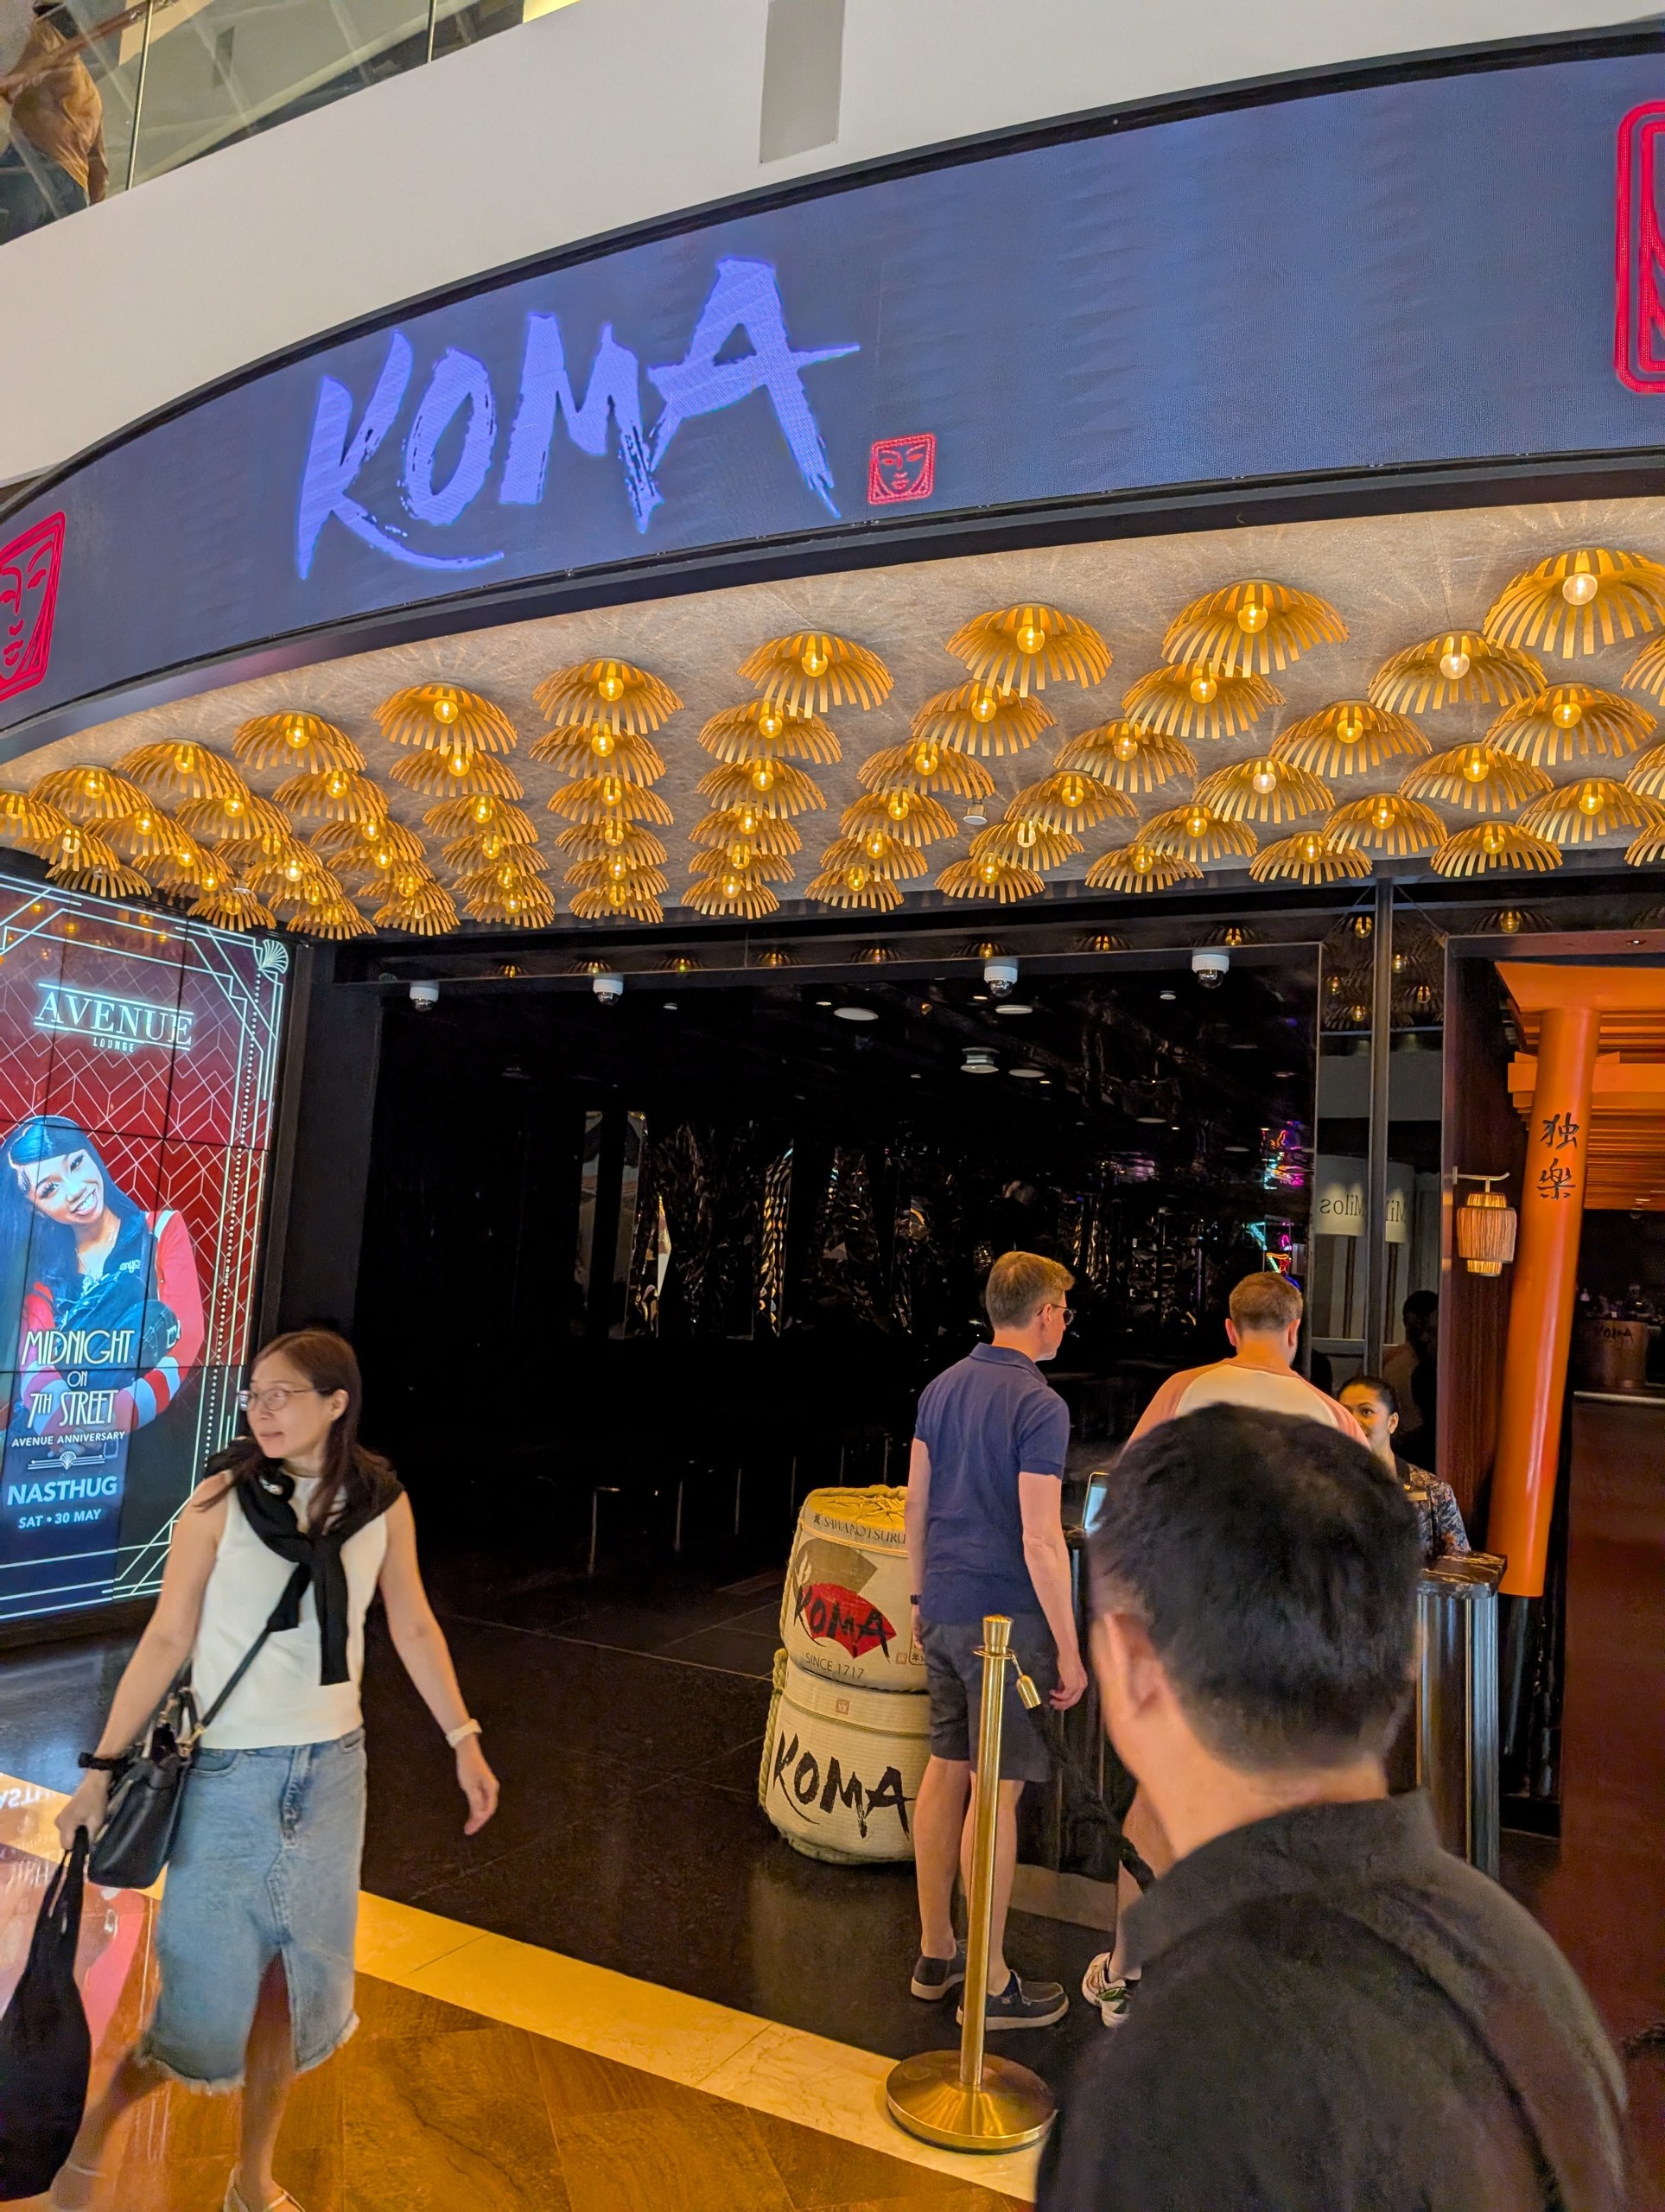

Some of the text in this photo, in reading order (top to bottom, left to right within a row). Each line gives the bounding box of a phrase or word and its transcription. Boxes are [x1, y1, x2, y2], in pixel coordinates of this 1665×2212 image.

[299, 257, 860, 580] KOMA
[35, 990, 194, 1046] AVENUE
[92, 1037, 135, 1053] LOUNGE
[21, 1330, 135, 1365] MIDNIGHT
[67, 1370, 88, 1388] ON
[27, 1389, 119, 1429] 7TH STREET
[11, 1431, 125, 1448] AVENUE ANNIVERSARY
[7, 1476, 118, 1505] NASTHUG
[18, 1509, 102, 1529] SAT 30 MAY
[823, 1517, 906, 1543] SAWANOTSURU
[793, 1585, 897, 1664] KOMA
[804, 1652, 864, 1679] SINCE 1717
[773, 1731, 917, 1840] KOMA
